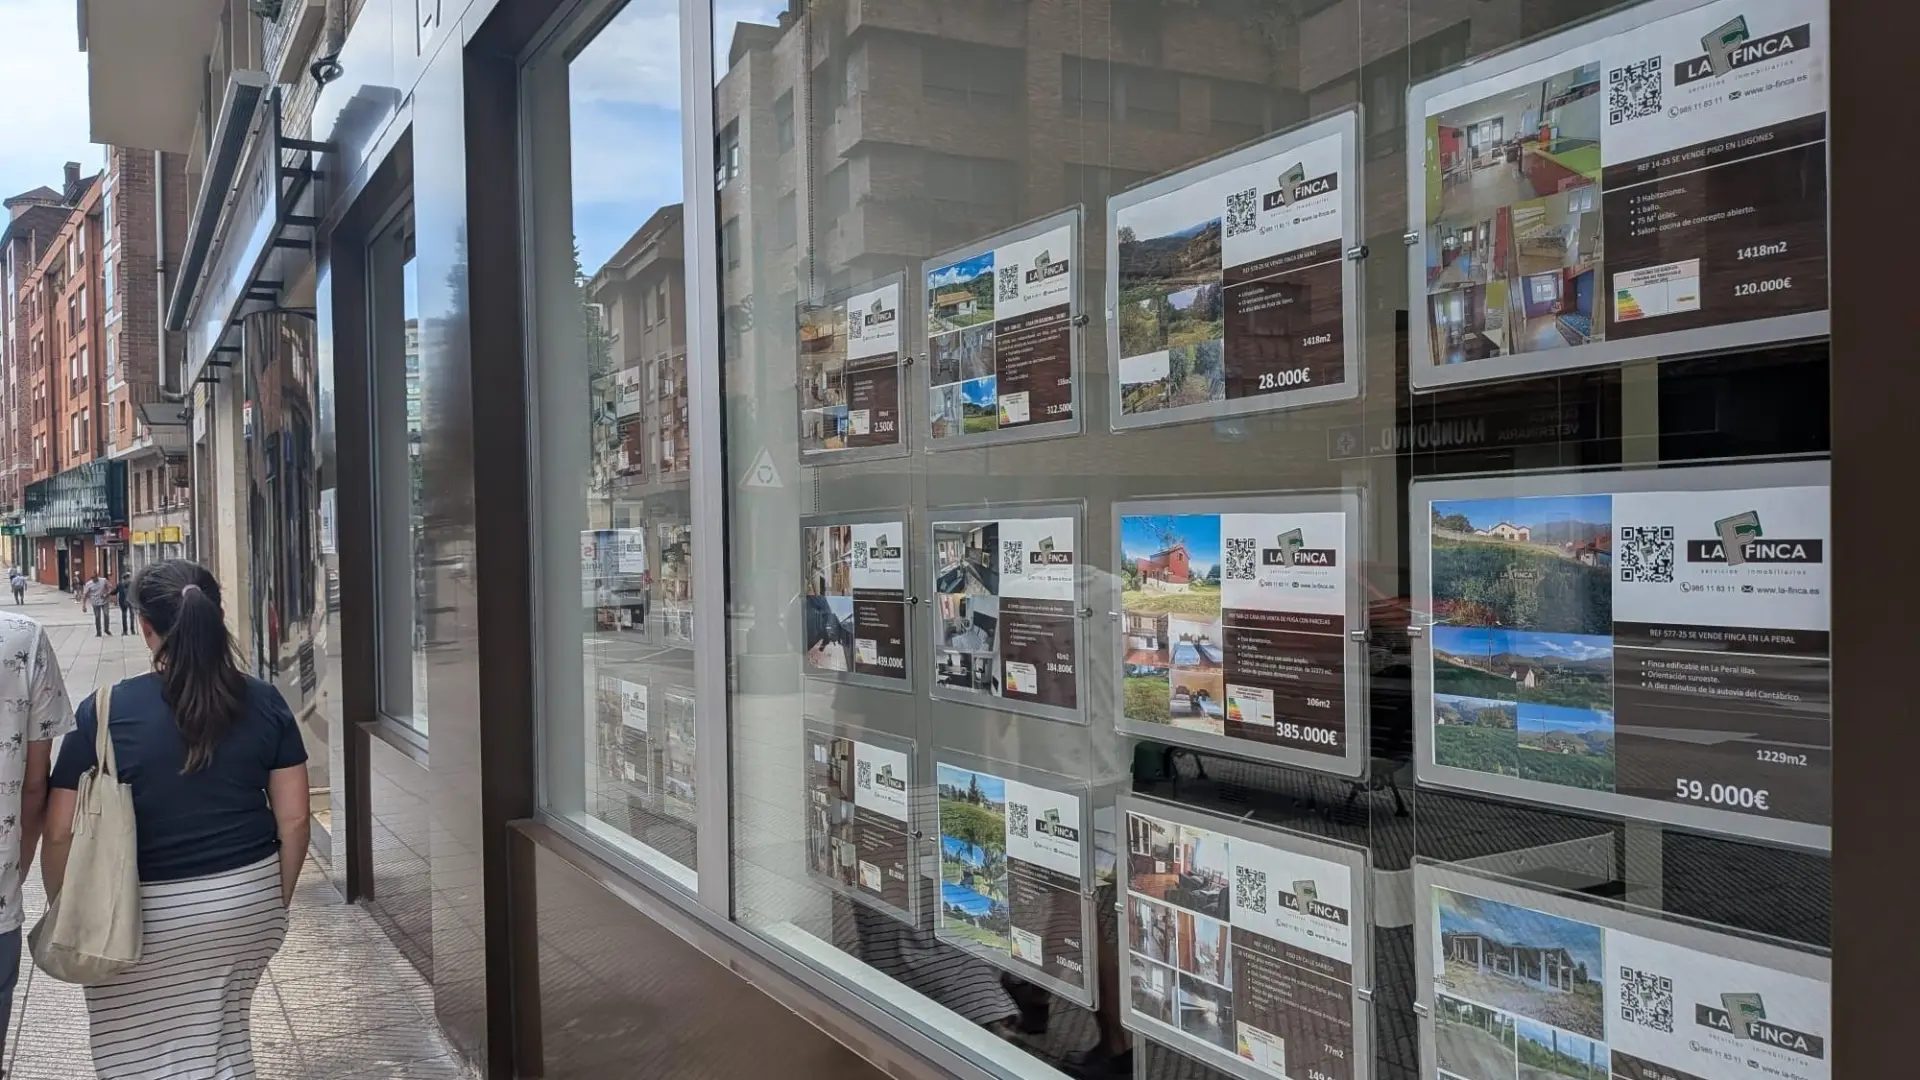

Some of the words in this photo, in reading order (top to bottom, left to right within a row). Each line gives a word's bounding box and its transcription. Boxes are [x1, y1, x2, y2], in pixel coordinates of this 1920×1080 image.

[1688, 60, 1712, 78] LA
[1732, 35, 1794, 65] FINCA
[1744, 74, 1808, 97] www.la-finca.es
[1637, 162, 1649, 172] REF
[1652, 158, 1670, 169] 14-25
[1672, 154, 1680, 163] SE
[1682, 148, 1705, 161] VENDE
[1706, 144, 1724, 156] PISO
[1725, 141, 1736, 150] EN
[1738, 132, 1774, 148] LUGONES
[1271, 193, 1284, 206] LA
[1295, 179, 1329, 198] FINCA
[1642, 186, 1688, 202] Habitaciones.
[1682, 218, 1692, 227] de
[1692, 212, 1726, 226] concepto
[1727, 206, 1756, 217] abierto.
[1737, 241, 1788, 260] 1418m2
[1734, 277, 1793, 296] 120.000€
[1303, 333, 1331, 346] 1418m2
[1259, 367, 1310, 390] 28.000€
[1270, 552, 1284, 563] LA
[1294, 552, 1328, 564] FINCA
[1701, 544, 1725, 559] LA
[1745, 544, 1807, 559] FINCA
[1756, 586, 1820, 595] www.la-finca.es
[1664, 630, 1687, 639] 577-25
[1688, 631, 1696, 640] SE
[1700, 632, 1722, 640] VENDE
[1724, 633, 1746, 642] FINCA
[1748, 634, 1758, 642] EN
[1760, 635, 1770, 643] LA
[1771, 636, 1795, 644] PERAL
[1648, 660, 1664, 668] Finca
[1666, 661, 1698, 672] edificable
[1711, 664, 1720, 672] La
[1720, 665, 1739, 674] Peral
[1688, 674, 1720, 684] suroeste.
[1654, 682, 1668, 690] diez
[1669, 684, 1696, 692] minutos
[1698, 686, 1708, 694] de
[1745, 690, 1756, 698] del
[1306, 697, 1331, 708] 106m2
[1276, 722, 1338, 746] 385.000€
[1756, 750, 1808, 766] 1229m2
[1676, 778, 1770, 810] 59.000€
[1285, 896, 1298, 908] LA
[1308, 902, 1340, 920] FINCA
[1708, 1011, 1731, 1030] LA
[1750, 1023, 1808, 1052] FINCA
[1324, 1044, 1344, 1059] 77m2
